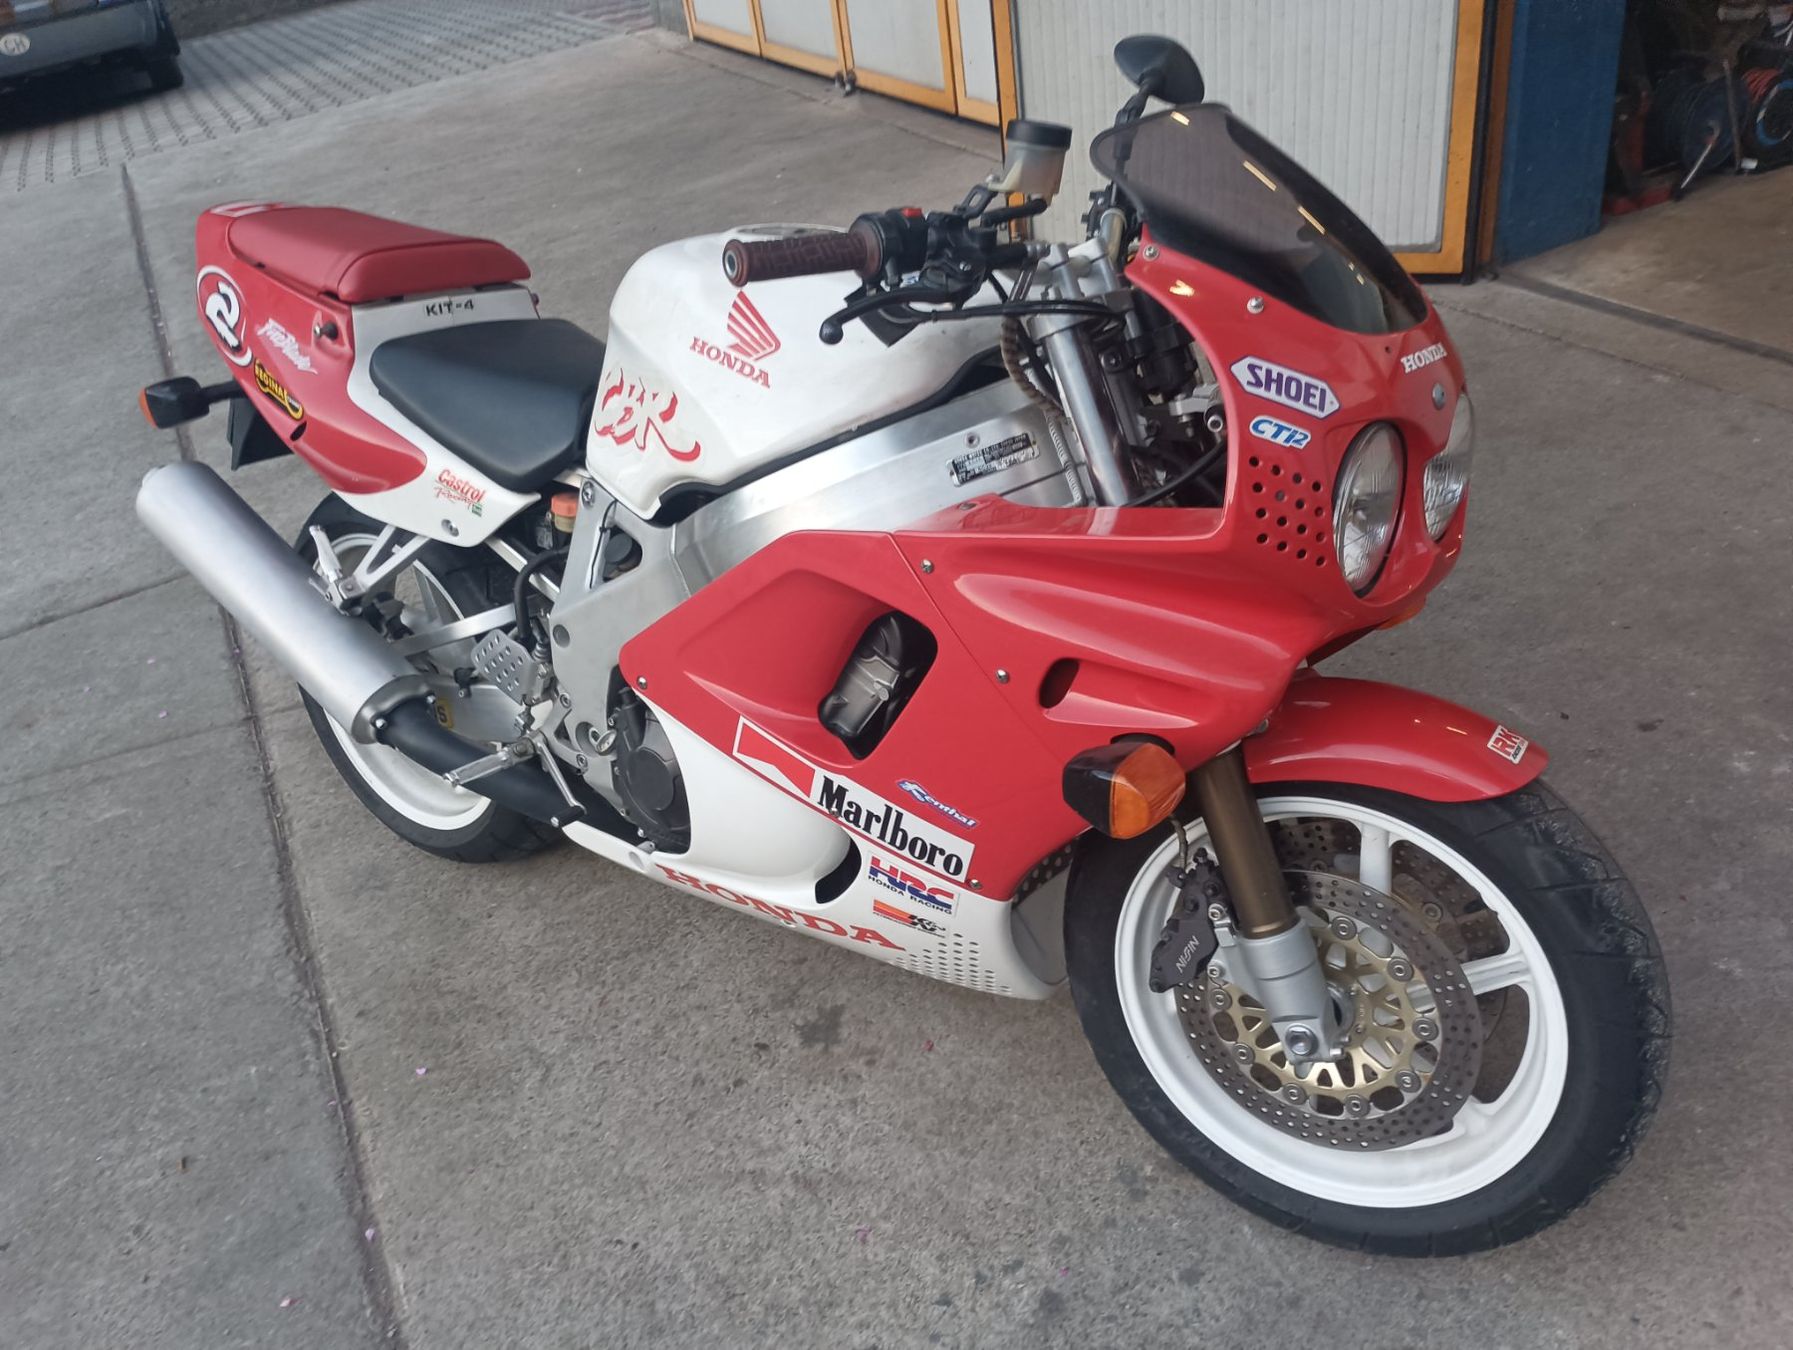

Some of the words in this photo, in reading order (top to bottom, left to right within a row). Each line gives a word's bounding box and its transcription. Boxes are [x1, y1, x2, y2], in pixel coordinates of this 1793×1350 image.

[426, 299, 474, 317] KIT-4
[689, 336, 771, 389] HONDA
[1400, 343, 1448, 373] HONDA
[1246, 363, 1327, 413] SHOEI
[594, 368, 701, 462] CBR
[438, 469, 486, 503] Castrol
[1491, 727, 1521, 757] RK
[817, 775, 964, 876] Marlboro
[655, 863, 906, 952] HONDA
[868, 875, 905, 897] HONDA
[910, 895, 953, 915] RACING
[869, 856, 955, 910] HRC
